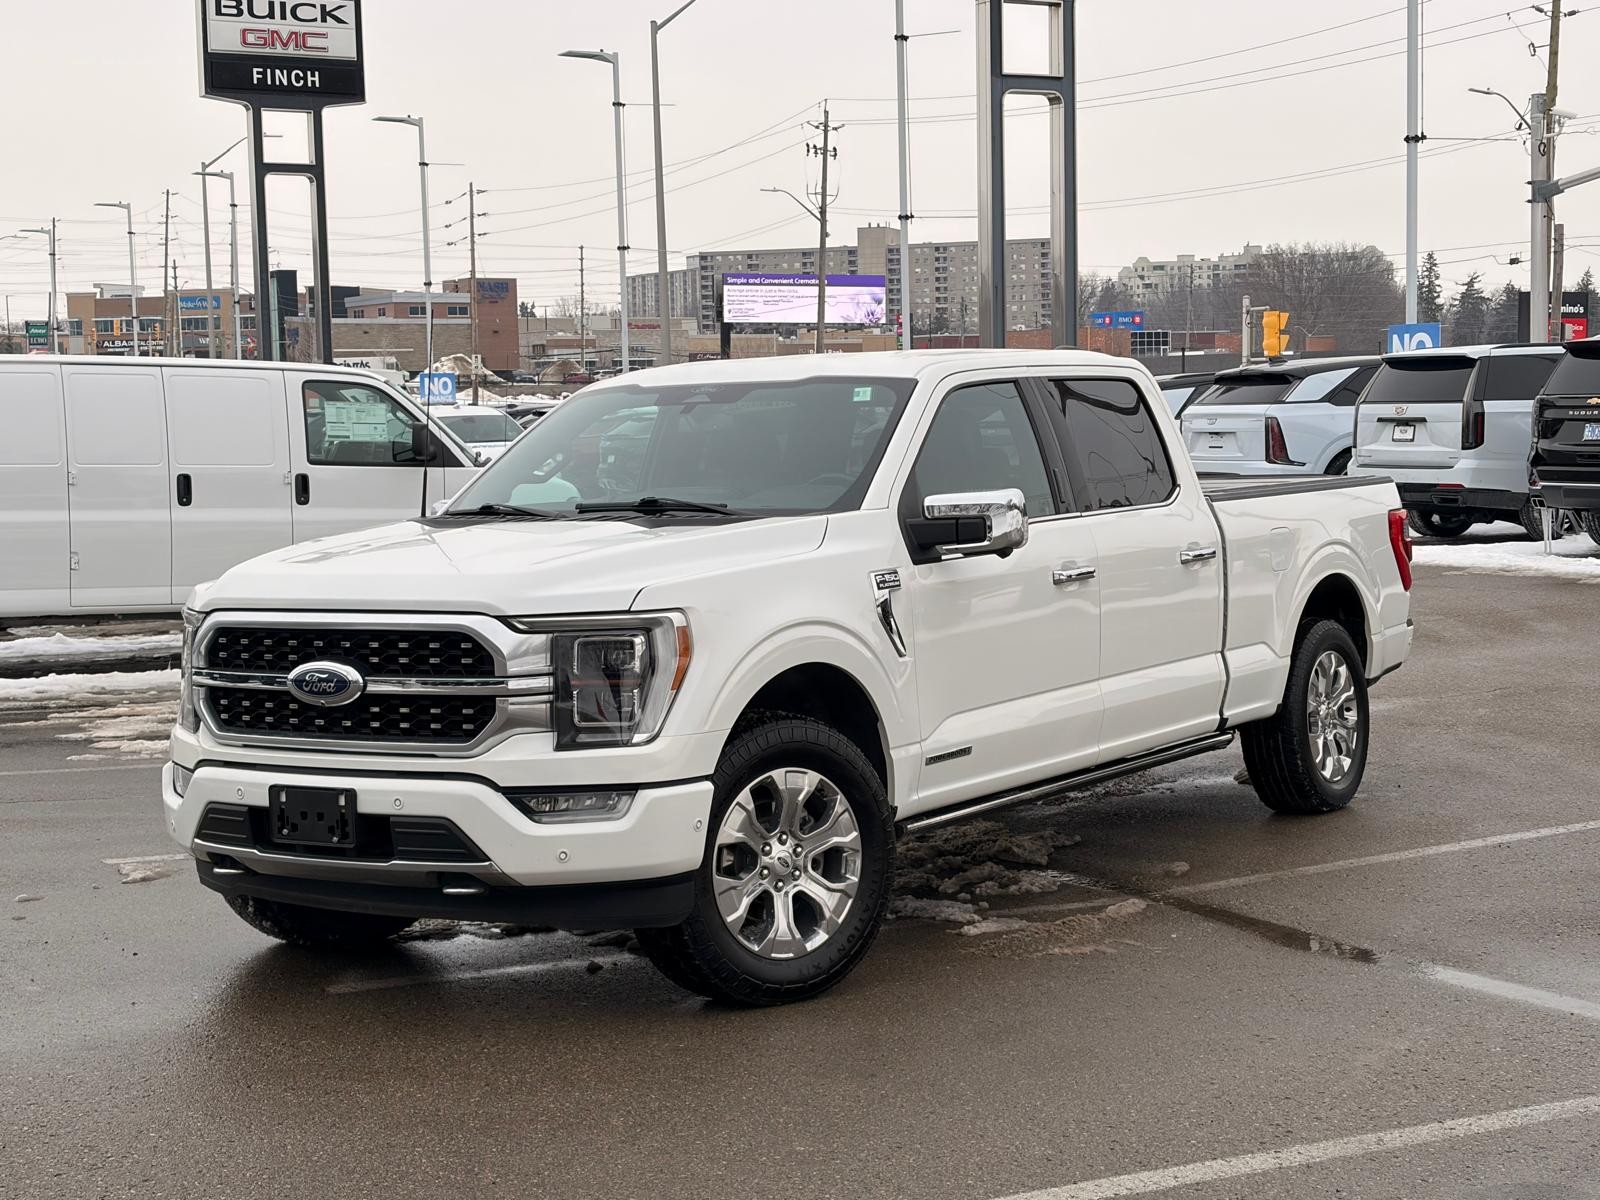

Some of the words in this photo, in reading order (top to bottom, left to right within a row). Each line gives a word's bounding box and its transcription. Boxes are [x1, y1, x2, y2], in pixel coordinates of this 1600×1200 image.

[214, 0, 349, 24] BUICK
[240, 27, 328, 52] GMC
[252, 67, 320, 88] FINCH
[103, 340, 128, 348] ALBA
[1392, 332, 1433, 352] NO
[423, 376, 453, 396] NO
[876, 573, 900, 583] F-150
[302, 672, 337, 692] Ford
